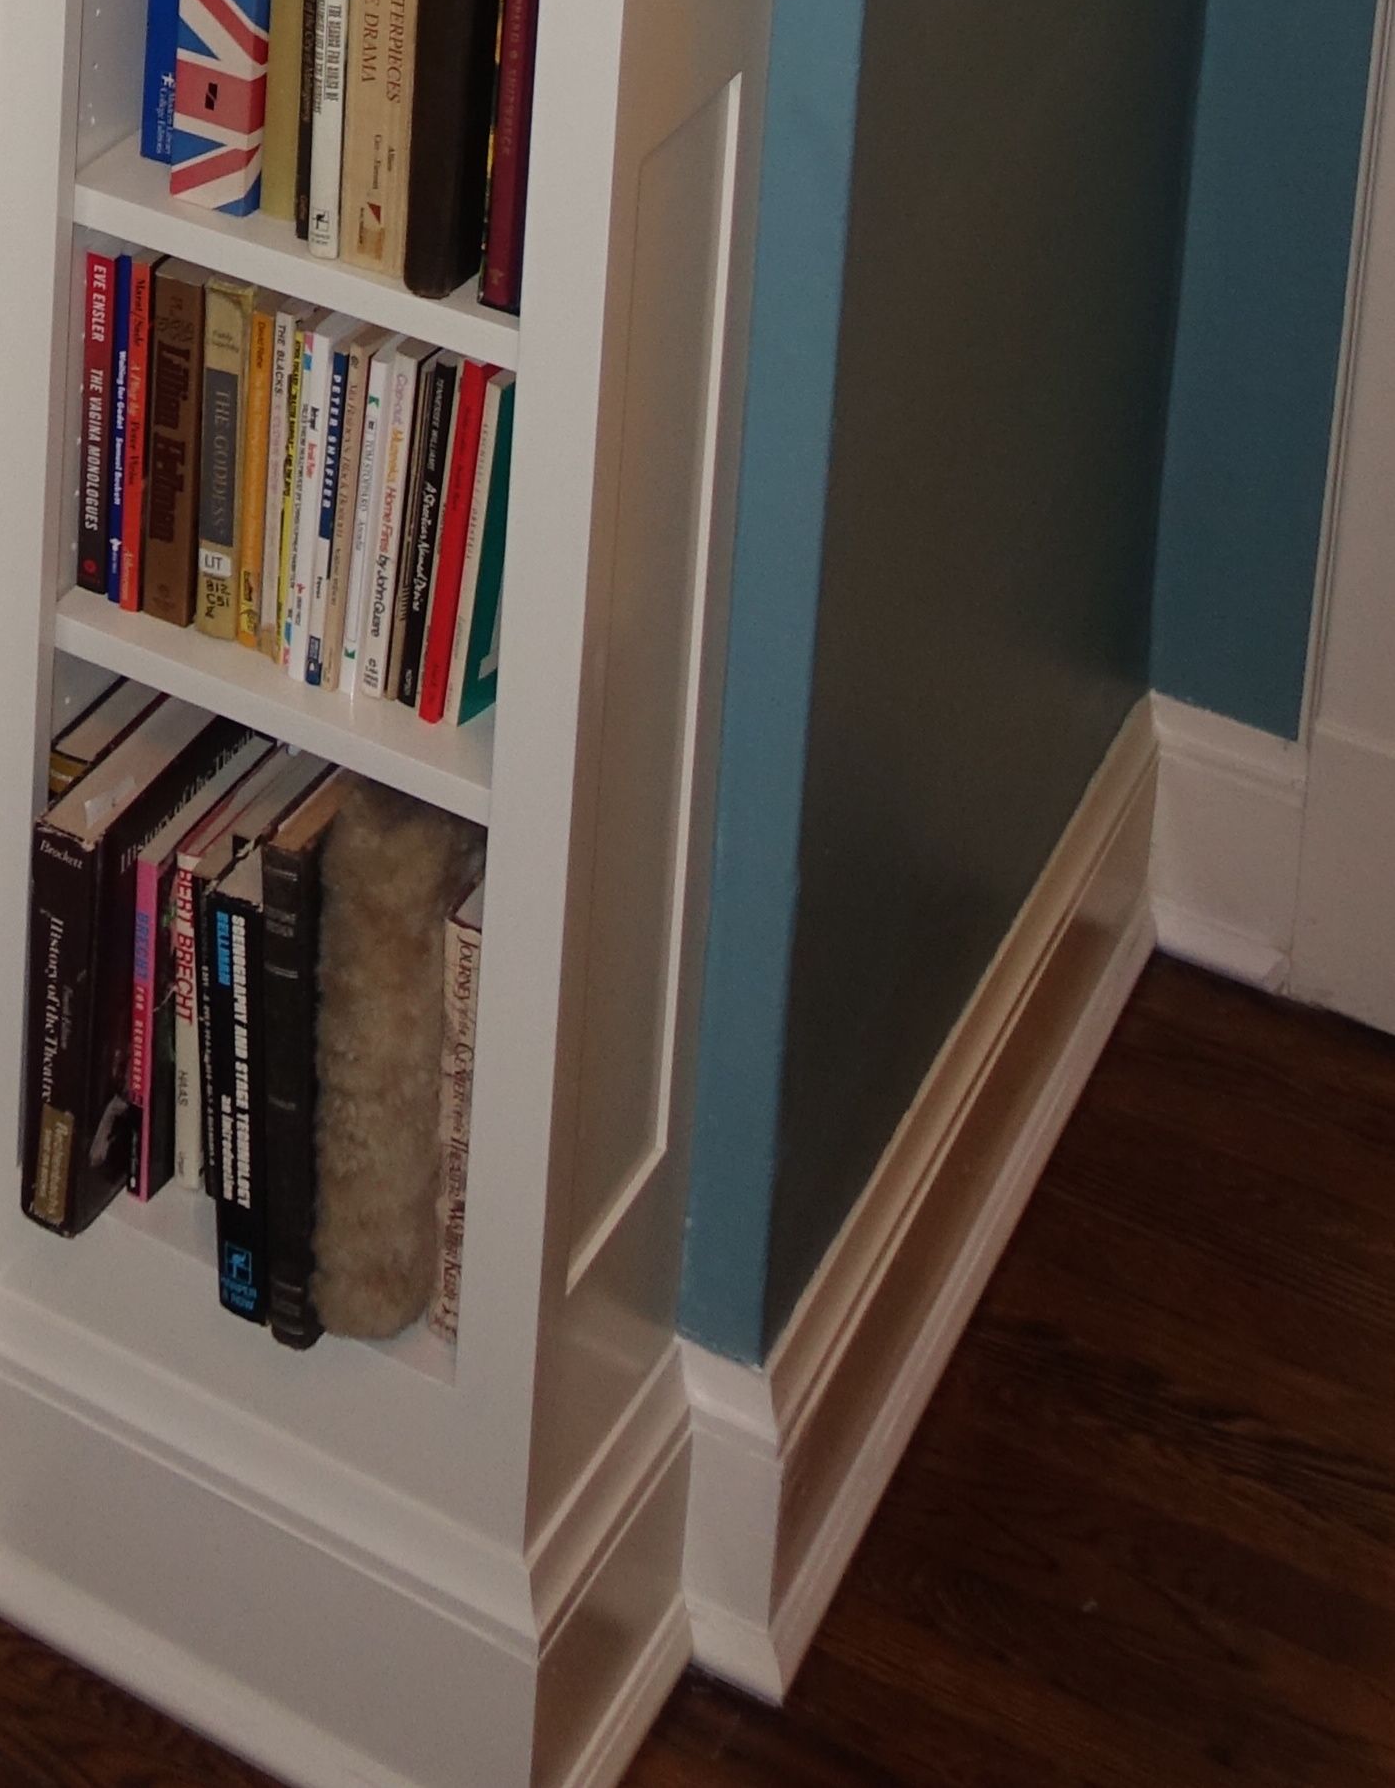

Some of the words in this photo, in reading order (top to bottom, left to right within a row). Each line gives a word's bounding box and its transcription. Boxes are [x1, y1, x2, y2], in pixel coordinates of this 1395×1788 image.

[361, 17, 377, 82] DRAMA
[93, 265, 107, 290] EVE
[90, 295, 106, 341] ENSLER
[89, 369, 104, 390] THE
[87, 394, 103, 453] VAGINA
[84, 456, 101, 532] MONOLOGUES
[177, 868, 196, 924] BERT
[176, 929, 195, 1024] BRECHT
